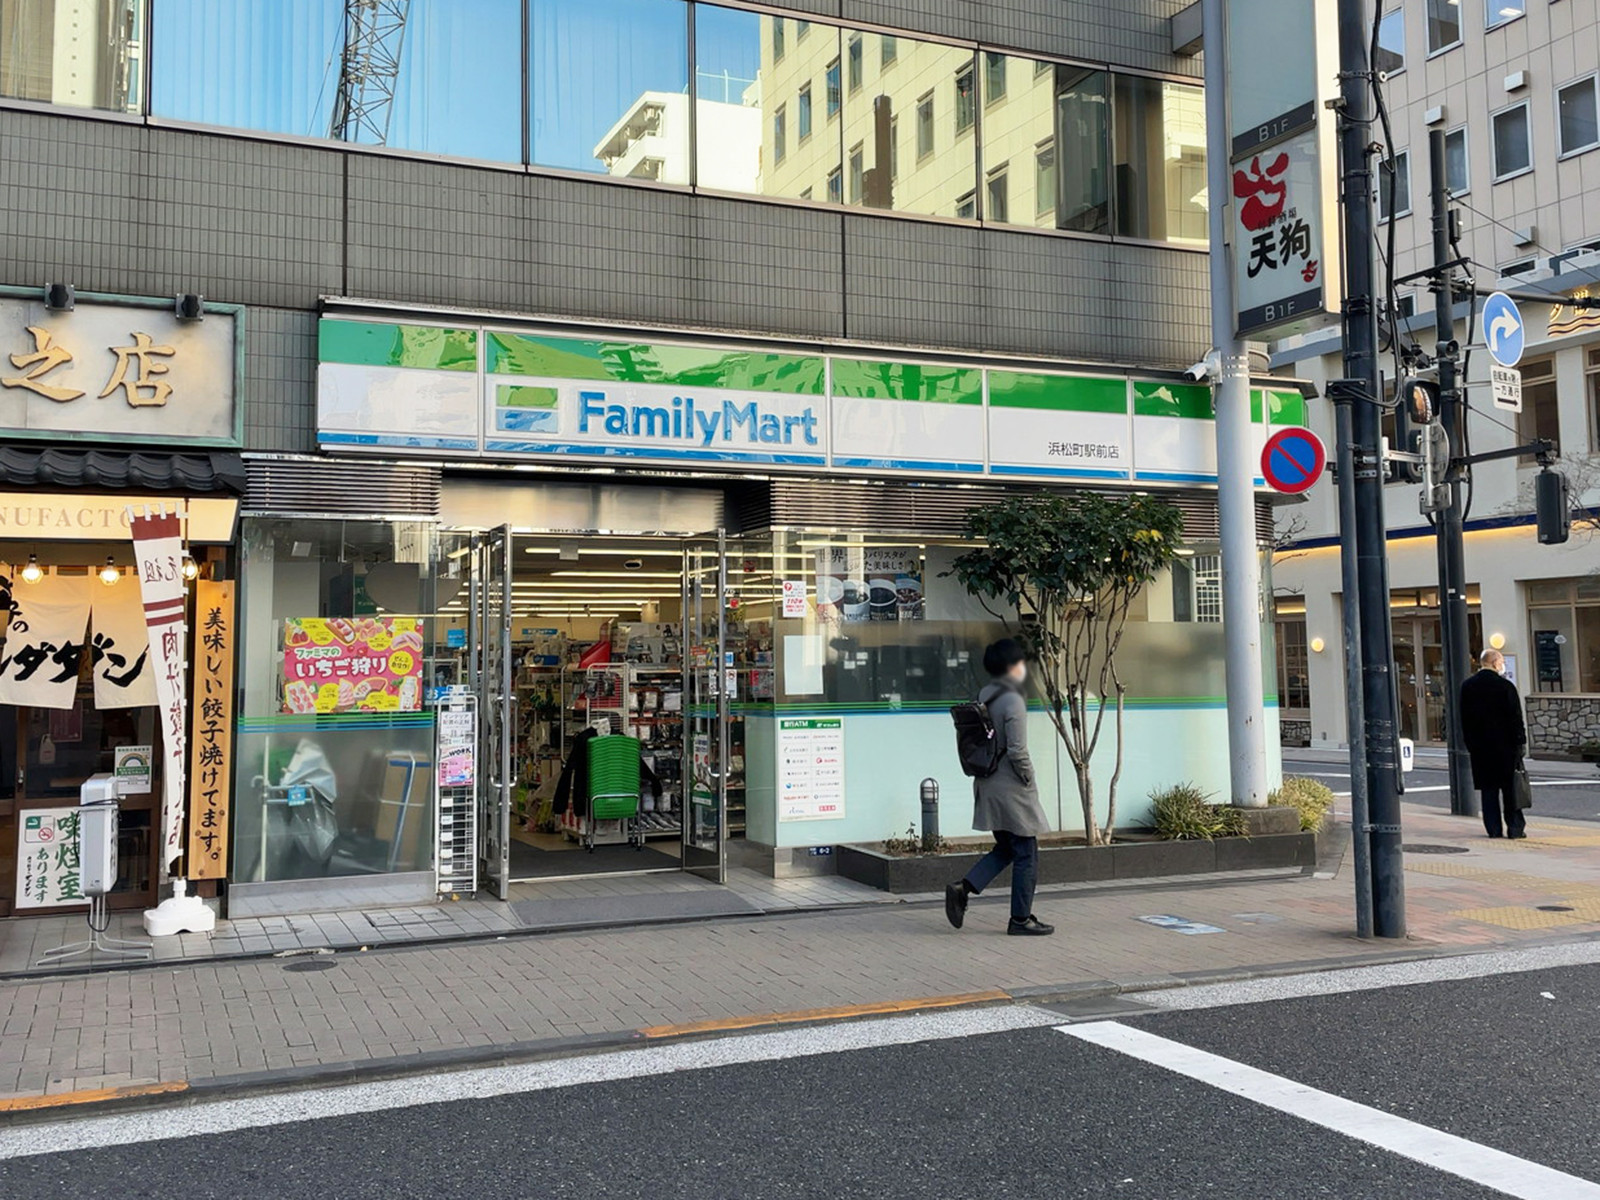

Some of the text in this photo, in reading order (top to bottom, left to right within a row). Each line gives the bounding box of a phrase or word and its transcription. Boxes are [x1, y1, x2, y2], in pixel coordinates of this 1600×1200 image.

[1247, 217, 1311, 279] 天狗
[0, 326, 176, 409] 之店
[577, 390, 818, 447] FamilyMart
[1048, 441, 1119, 459] 浜松町駅前店
[295, 648, 340, 659] ファミマの
[295, 656, 387, 678] いちご狩り
[199, 607, 227, 861] 美味しい餃子焼けてます。
[34, 847, 50, 904] あります
